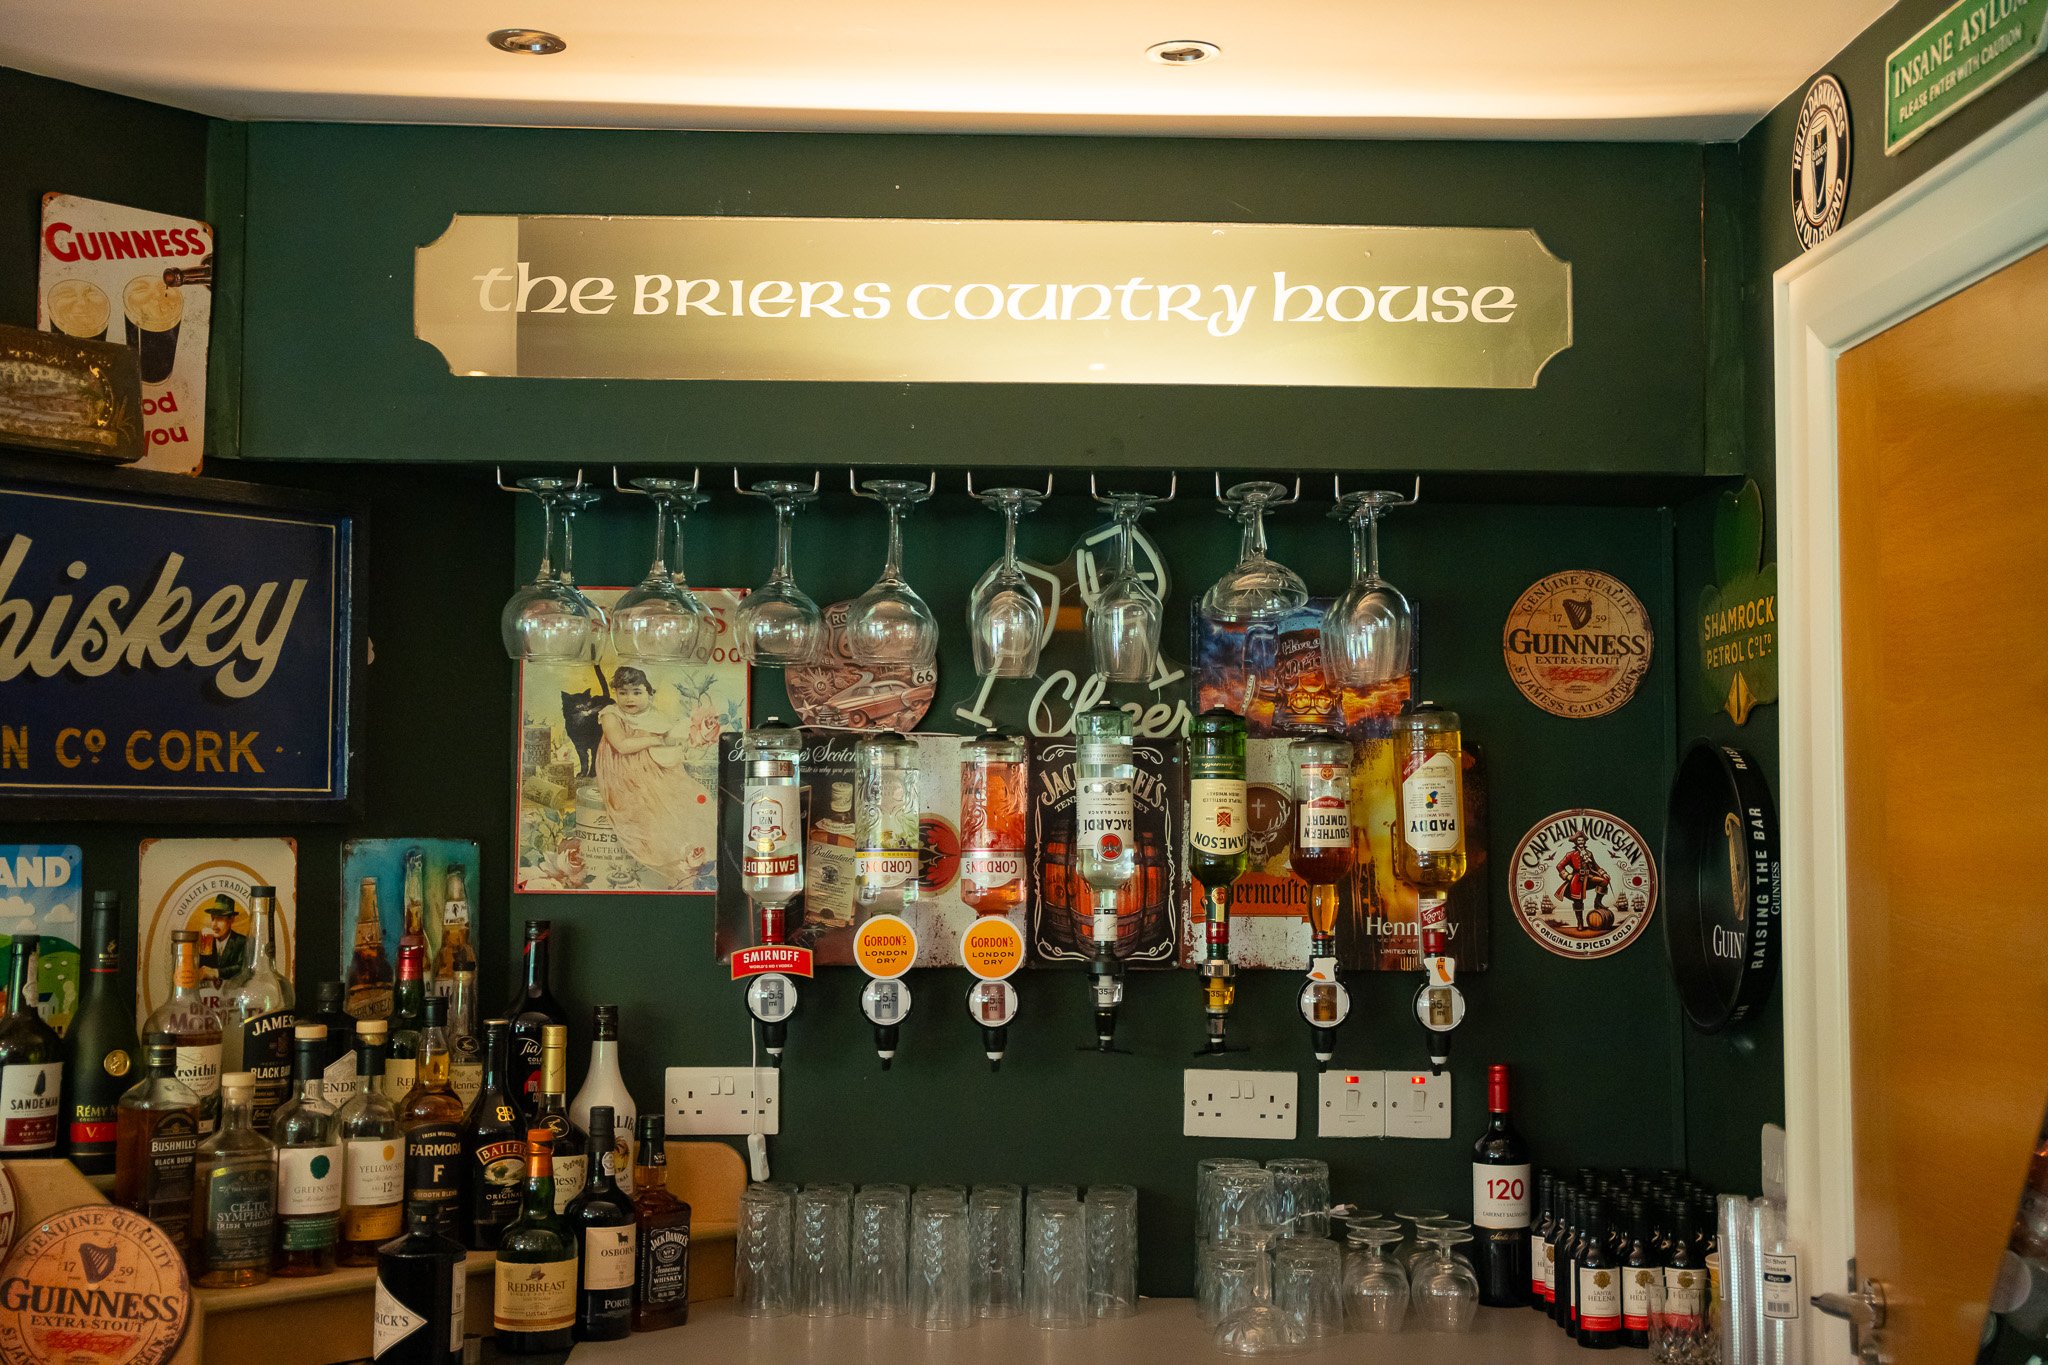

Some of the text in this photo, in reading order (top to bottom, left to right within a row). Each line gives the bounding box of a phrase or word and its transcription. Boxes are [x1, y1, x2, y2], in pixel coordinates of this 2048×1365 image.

[1894, 0, 2029, 98] INSANE ASYLU
[1899, 90, 1928, 123] PLEASE
[1929, 70, 1957, 102] ENTER
[1794, 108, 1810, 170] HELLO
[1818, 178, 1844, 242] FRIEND
[45, 222, 206, 263] GUINNESS
[142, 391, 178, 416] od
[1521, 575, 1637, 616] GENUINE QUALITY
[0, 533, 308, 698] hiskey
[1704, 595, 1775, 641] SHAMROCK
[1508, 628, 1646, 656] GUINNESS
[1706, 641, 1745, 670] PETROL
[916, 670, 934, 684] 66
[1567, 701, 1604, 714] GATE
[125, 730, 266, 774] CORK
[1038, 763, 1076, 806] JAC
[1306, 815, 1347, 827] COMFORT
[1410, 819, 1456, 833] PADDY
[1194, 831, 1247, 849] JAMESON
[1304, 827, 1350, 840] SOUTHERN
[1521, 817, 1643, 868] CAPTAIN MORGAN
[860, 860, 912, 874] GORDON'S
[966, 860, 1018, 875] GORDON'S
[211, 880, 217, 889] E
[1748, 807, 1769, 969] RAISING THE BAR
[1770, 860, 1780, 916] GUINNESS
[864, 934, 907, 947] GORDON'S
[971, 936, 1013, 949] GORDON'S
[1540, 924, 1633, 950] ORIGINAL SPICED GOLD
[1712, 924, 1745, 960] GUIN
[743, 951, 800, 964] SMIRNOFF
[176, 1063, 218, 1077] roithli
[76, 1104, 108, 1118] RÉMY
[151, 1138, 197, 1152] BUSHMILLS
[154, 1156, 176, 1166] BLACK
[360, 1164, 392, 1174] YELLOW
[432, 1164, 445, 1183] F
[382, 1181, 393, 1193] 12
[554, 1174, 577, 1188] nessy
[294, 1185, 326, 1194] GREEN
[414, 1190, 440, 1199] SMOOTH
[1486, 1178, 1525, 1200] 120
[230, 1201, 268, 1213] CELTIC
[216, 1221, 241, 1229] IRISH
[24, 1213, 174, 1270] GENUINE QUALITY
[62, 1261, 134, 1277] 17 59
[507, 1280, 566, 1293] REDBREAST
[1, 1276, 179, 1322] GUINNESS
[375, 1314, 409, 1327] RICK'S
